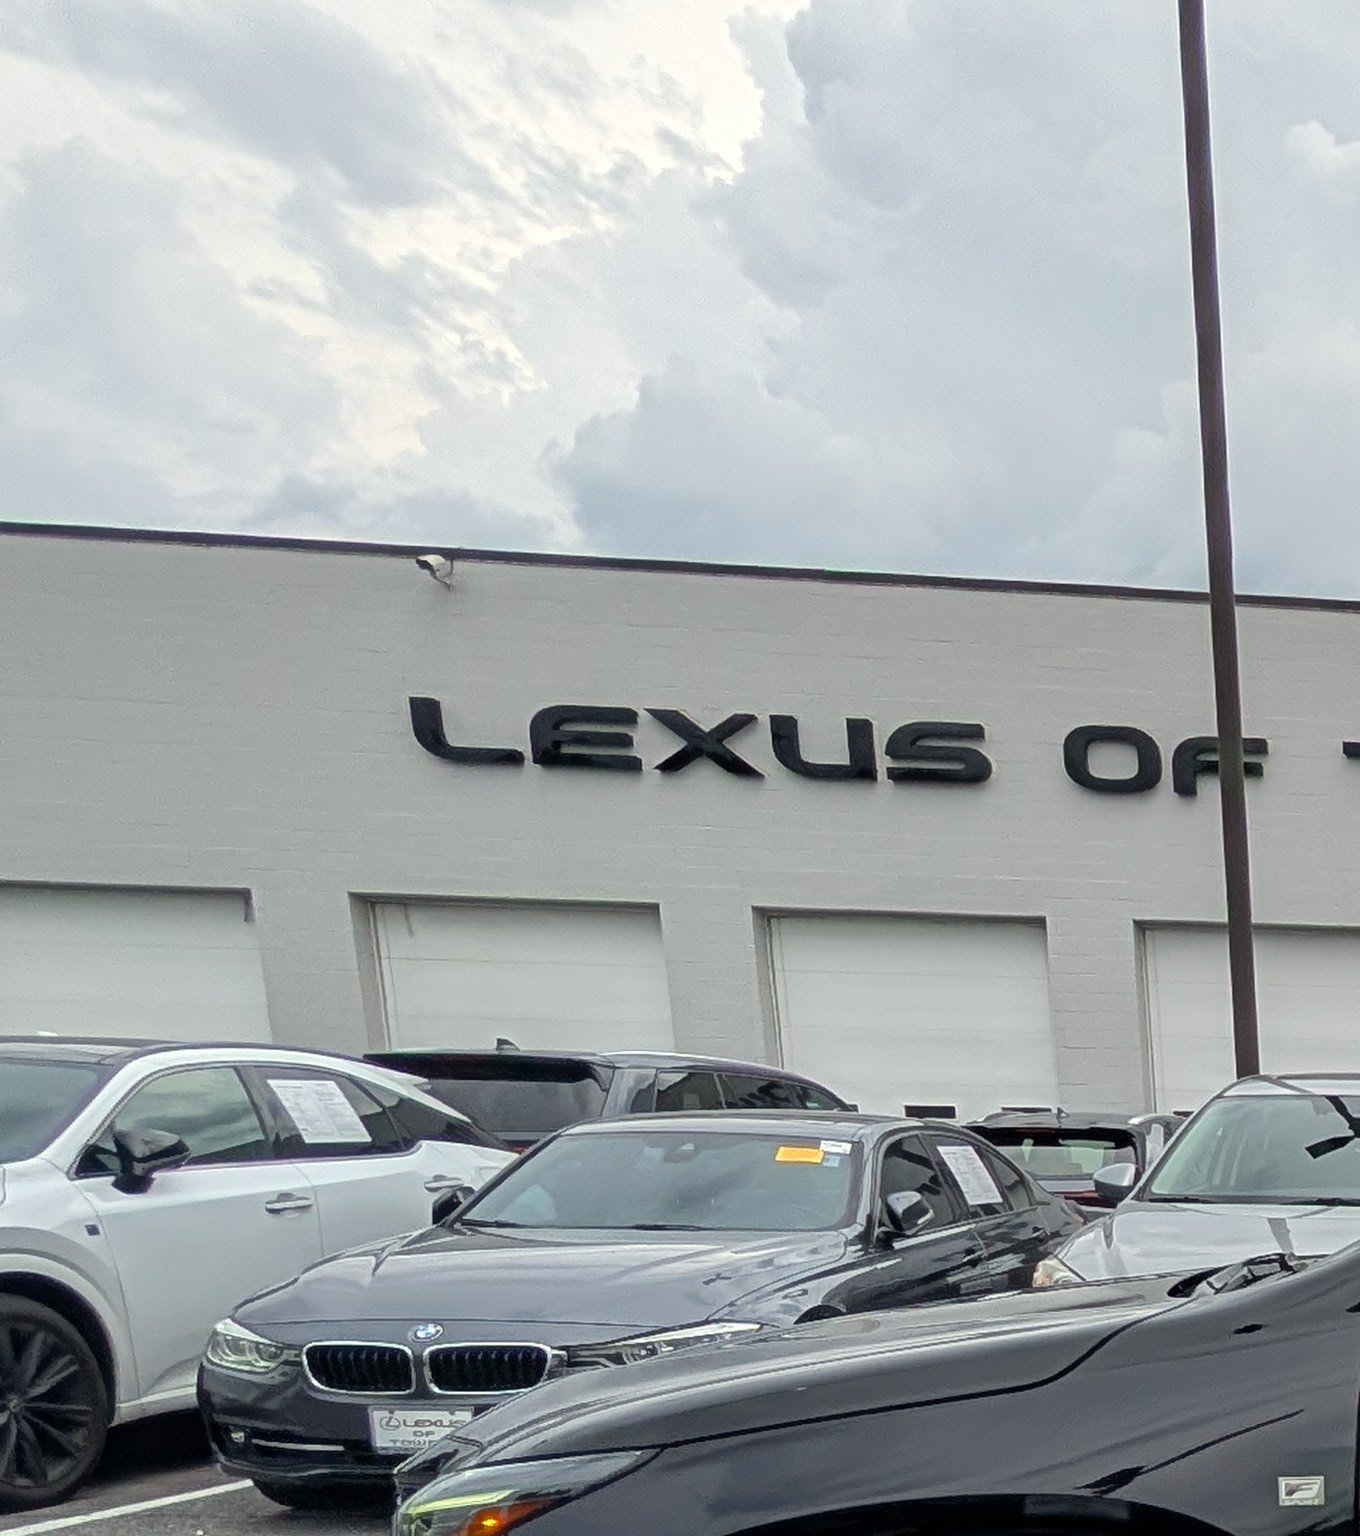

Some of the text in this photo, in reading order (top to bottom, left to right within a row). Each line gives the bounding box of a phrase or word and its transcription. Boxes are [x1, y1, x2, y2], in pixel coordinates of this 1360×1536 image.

[408, 696, 993, 783] LEXUS
[1062, 724, 1269, 797] OF
[413, 1430, 435, 1438] OF
